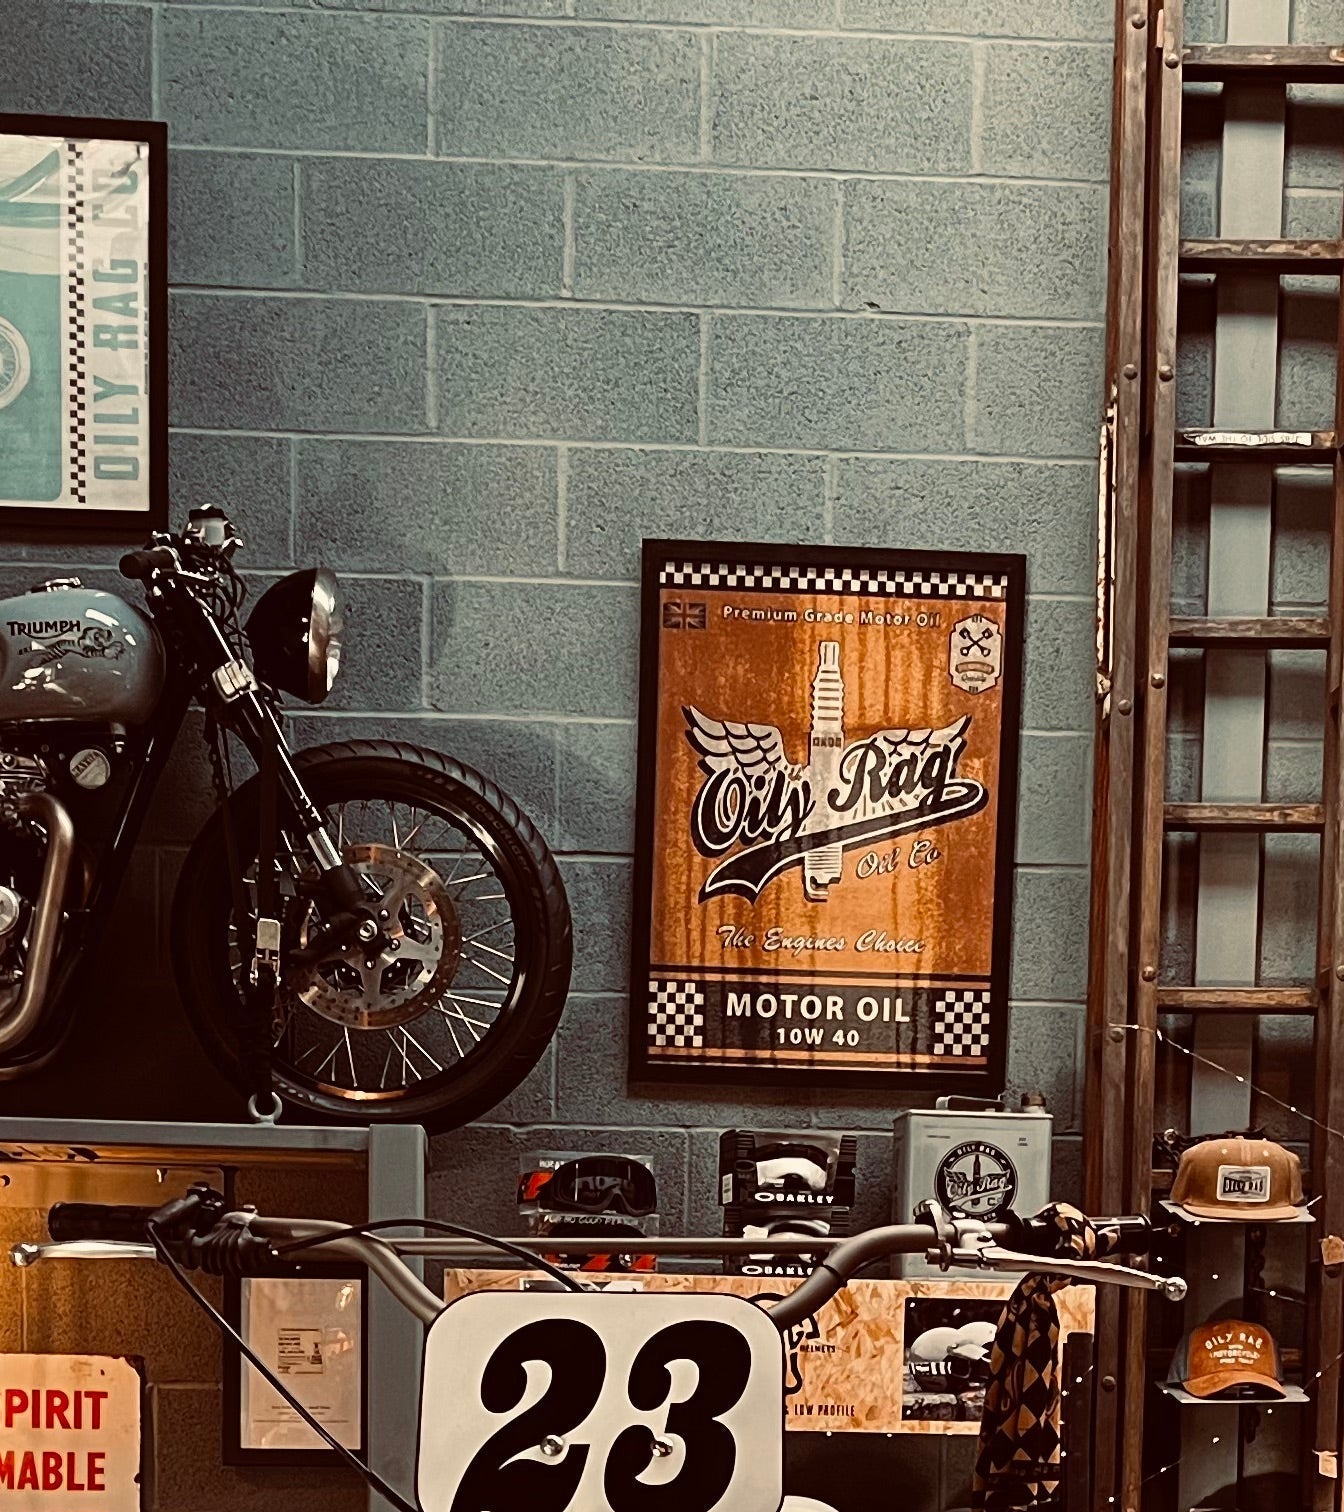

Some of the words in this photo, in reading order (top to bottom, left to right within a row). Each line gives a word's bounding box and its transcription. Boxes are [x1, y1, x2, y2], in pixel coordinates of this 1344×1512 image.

[94, 258, 140, 352] RAG
[94, 377, 141, 481] OILY
[7, 620, 81, 637] TRIUMPH
[723, 605, 797, 623] Premium
[804, 607, 854, 625] Grade
[860, 611, 910, 627] Motor
[916, 612, 941, 627] Oil
[692, 766, 816, 856] Oily
[828, 736, 976, 813] Rag
[856, 846, 899, 879] Oil
[908, 839, 942, 869] Co
[717, 925, 754, 949] The
[764, 926, 846, 956] Engines
[726, 991, 845, 1021] MOTOR
[856, 996, 911, 1023] OIL
[777, 1028, 823, 1046] 10W
[832, 1028, 860, 1047] 40
[794, 1403, 814, 1417] LOW
[817, 1404, 856, 1418] PROFILE
